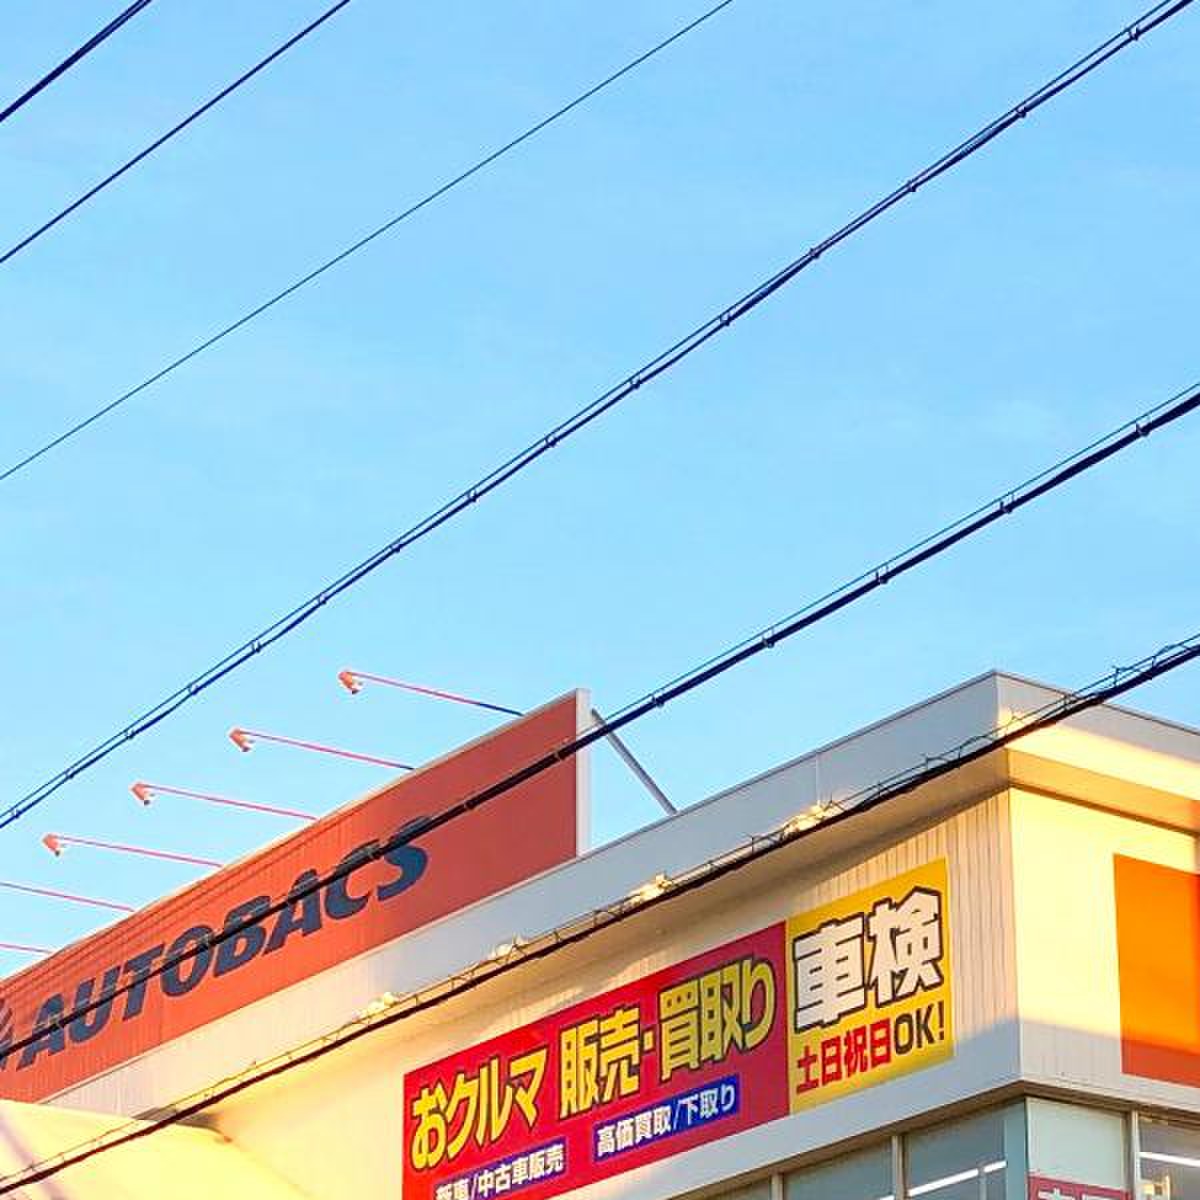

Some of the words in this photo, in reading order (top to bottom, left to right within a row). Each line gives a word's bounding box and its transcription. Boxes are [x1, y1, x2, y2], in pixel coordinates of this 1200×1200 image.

[17, 816, 430, 1071] AUTOBACS
[792, 886, 943, 1034] 車検
[410, 1046, 548, 1171] おクルマ
[559, 955, 776, 1119] 販売・買取り
[596, 1081, 737, 1156] 高価買取/下取り
[795, 1002, 946, 1093] 土日祝日OK!
